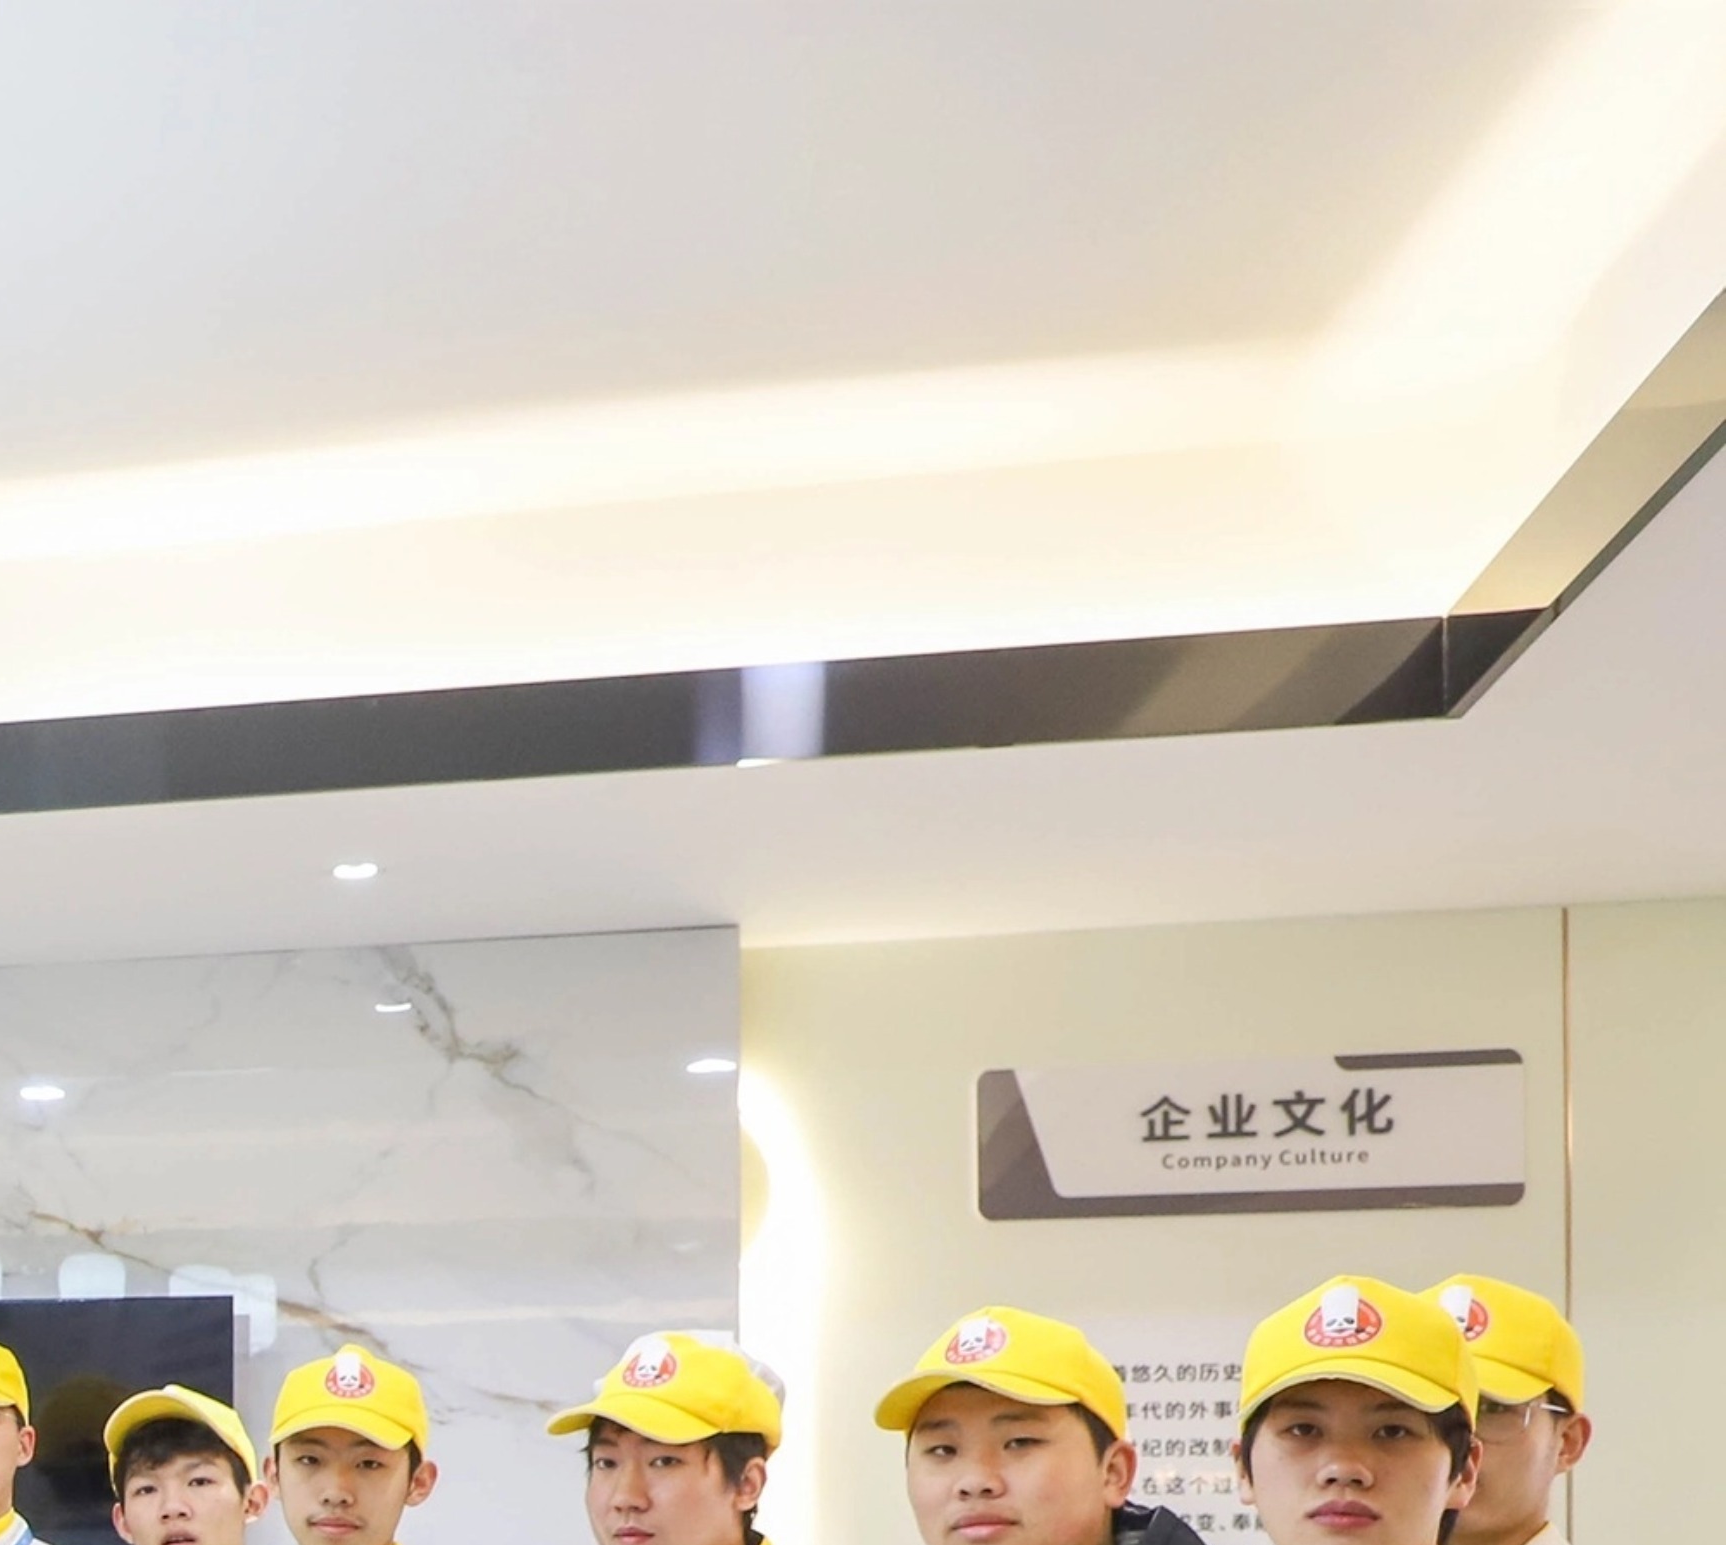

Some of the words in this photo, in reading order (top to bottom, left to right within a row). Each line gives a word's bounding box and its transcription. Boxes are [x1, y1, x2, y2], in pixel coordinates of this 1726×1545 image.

[1140, 1087, 1396, 1144] 企业文化
[1161, 1151, 1273, 1171] Company
[1278, 1147, 1371, 1167] Culture
[1127, 1400, 1241, 1420] 代的外事
[1132, 1438, 1233, 1458] 纪的改制
[1132, 1476, 1240, 1495] 在这个过
